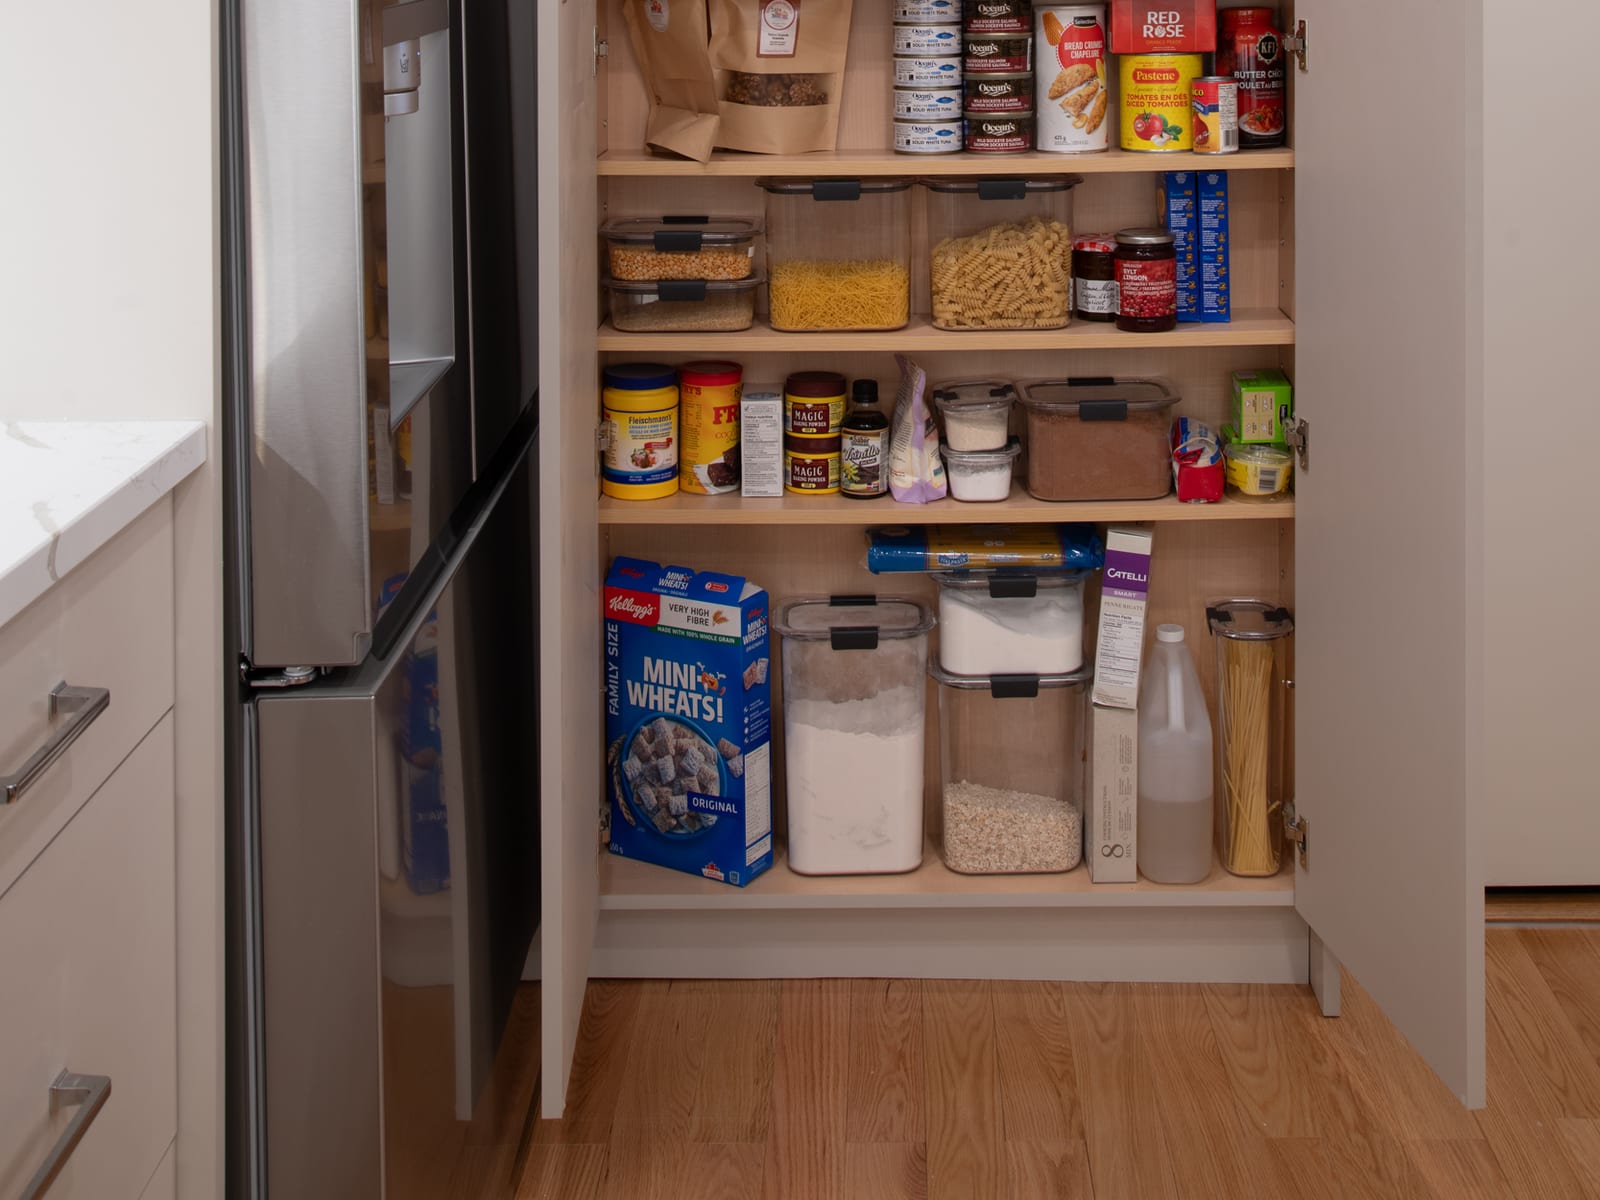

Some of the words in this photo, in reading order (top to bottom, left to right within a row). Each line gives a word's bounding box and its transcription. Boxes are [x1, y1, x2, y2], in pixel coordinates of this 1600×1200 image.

[978, 3, 1011, 14] Ocean's
[1147, 11, 1180, 24] RED
[1143, 25, 1184, 38] ROSE
[969, 43, 998, 54] Ocean's
[1064, 42, 1083, 50] BREAD
[1261, 42, 1275, 53] KFI
[1070, 50, 1100, 59] CHAPELURE
[1136, 70, 1175, 80] Pastene
[1234, 71, 1266, 79] BUTTER
[979, 83, 1012, 94] Ocean's
[982, 123, 1016, 134] Ocean's
[629, 414, 672, 424] Fleischmann's
[713, 405, 738, 424] FR
[795, 410, 824, 421] MAGIC
[794, 466, 823, 476] MAGIC
[1107, 568, 1147, 582] CATELLI
[658, 578, 689, 590] WHEATS!
[1114, 590, 1136, 598] SMART
[610, 594, 653, 619] Kellogg's
[669, 603, 688, 614] VERY
[691, 607, 710, 617] HIGH
[1104, 601, 1122, 609] PENNE
[1123, 603, 1142, 611] RIGATE
[687, 616, 709, 626] FIBRE
[608, 623, 618, 656] SIZE
[657, 626, 672, 634] MADE
[700, 633, 717, 642] WHOLE
[718, 636, 735, 644] GRAIN
[609, 661, 619, 715] FAMILY
[627, 680, 724, 723] WHEATS!
[692, 797, 738, 814] ORIGINAL
[1102, 844, 1123, 858] 8
